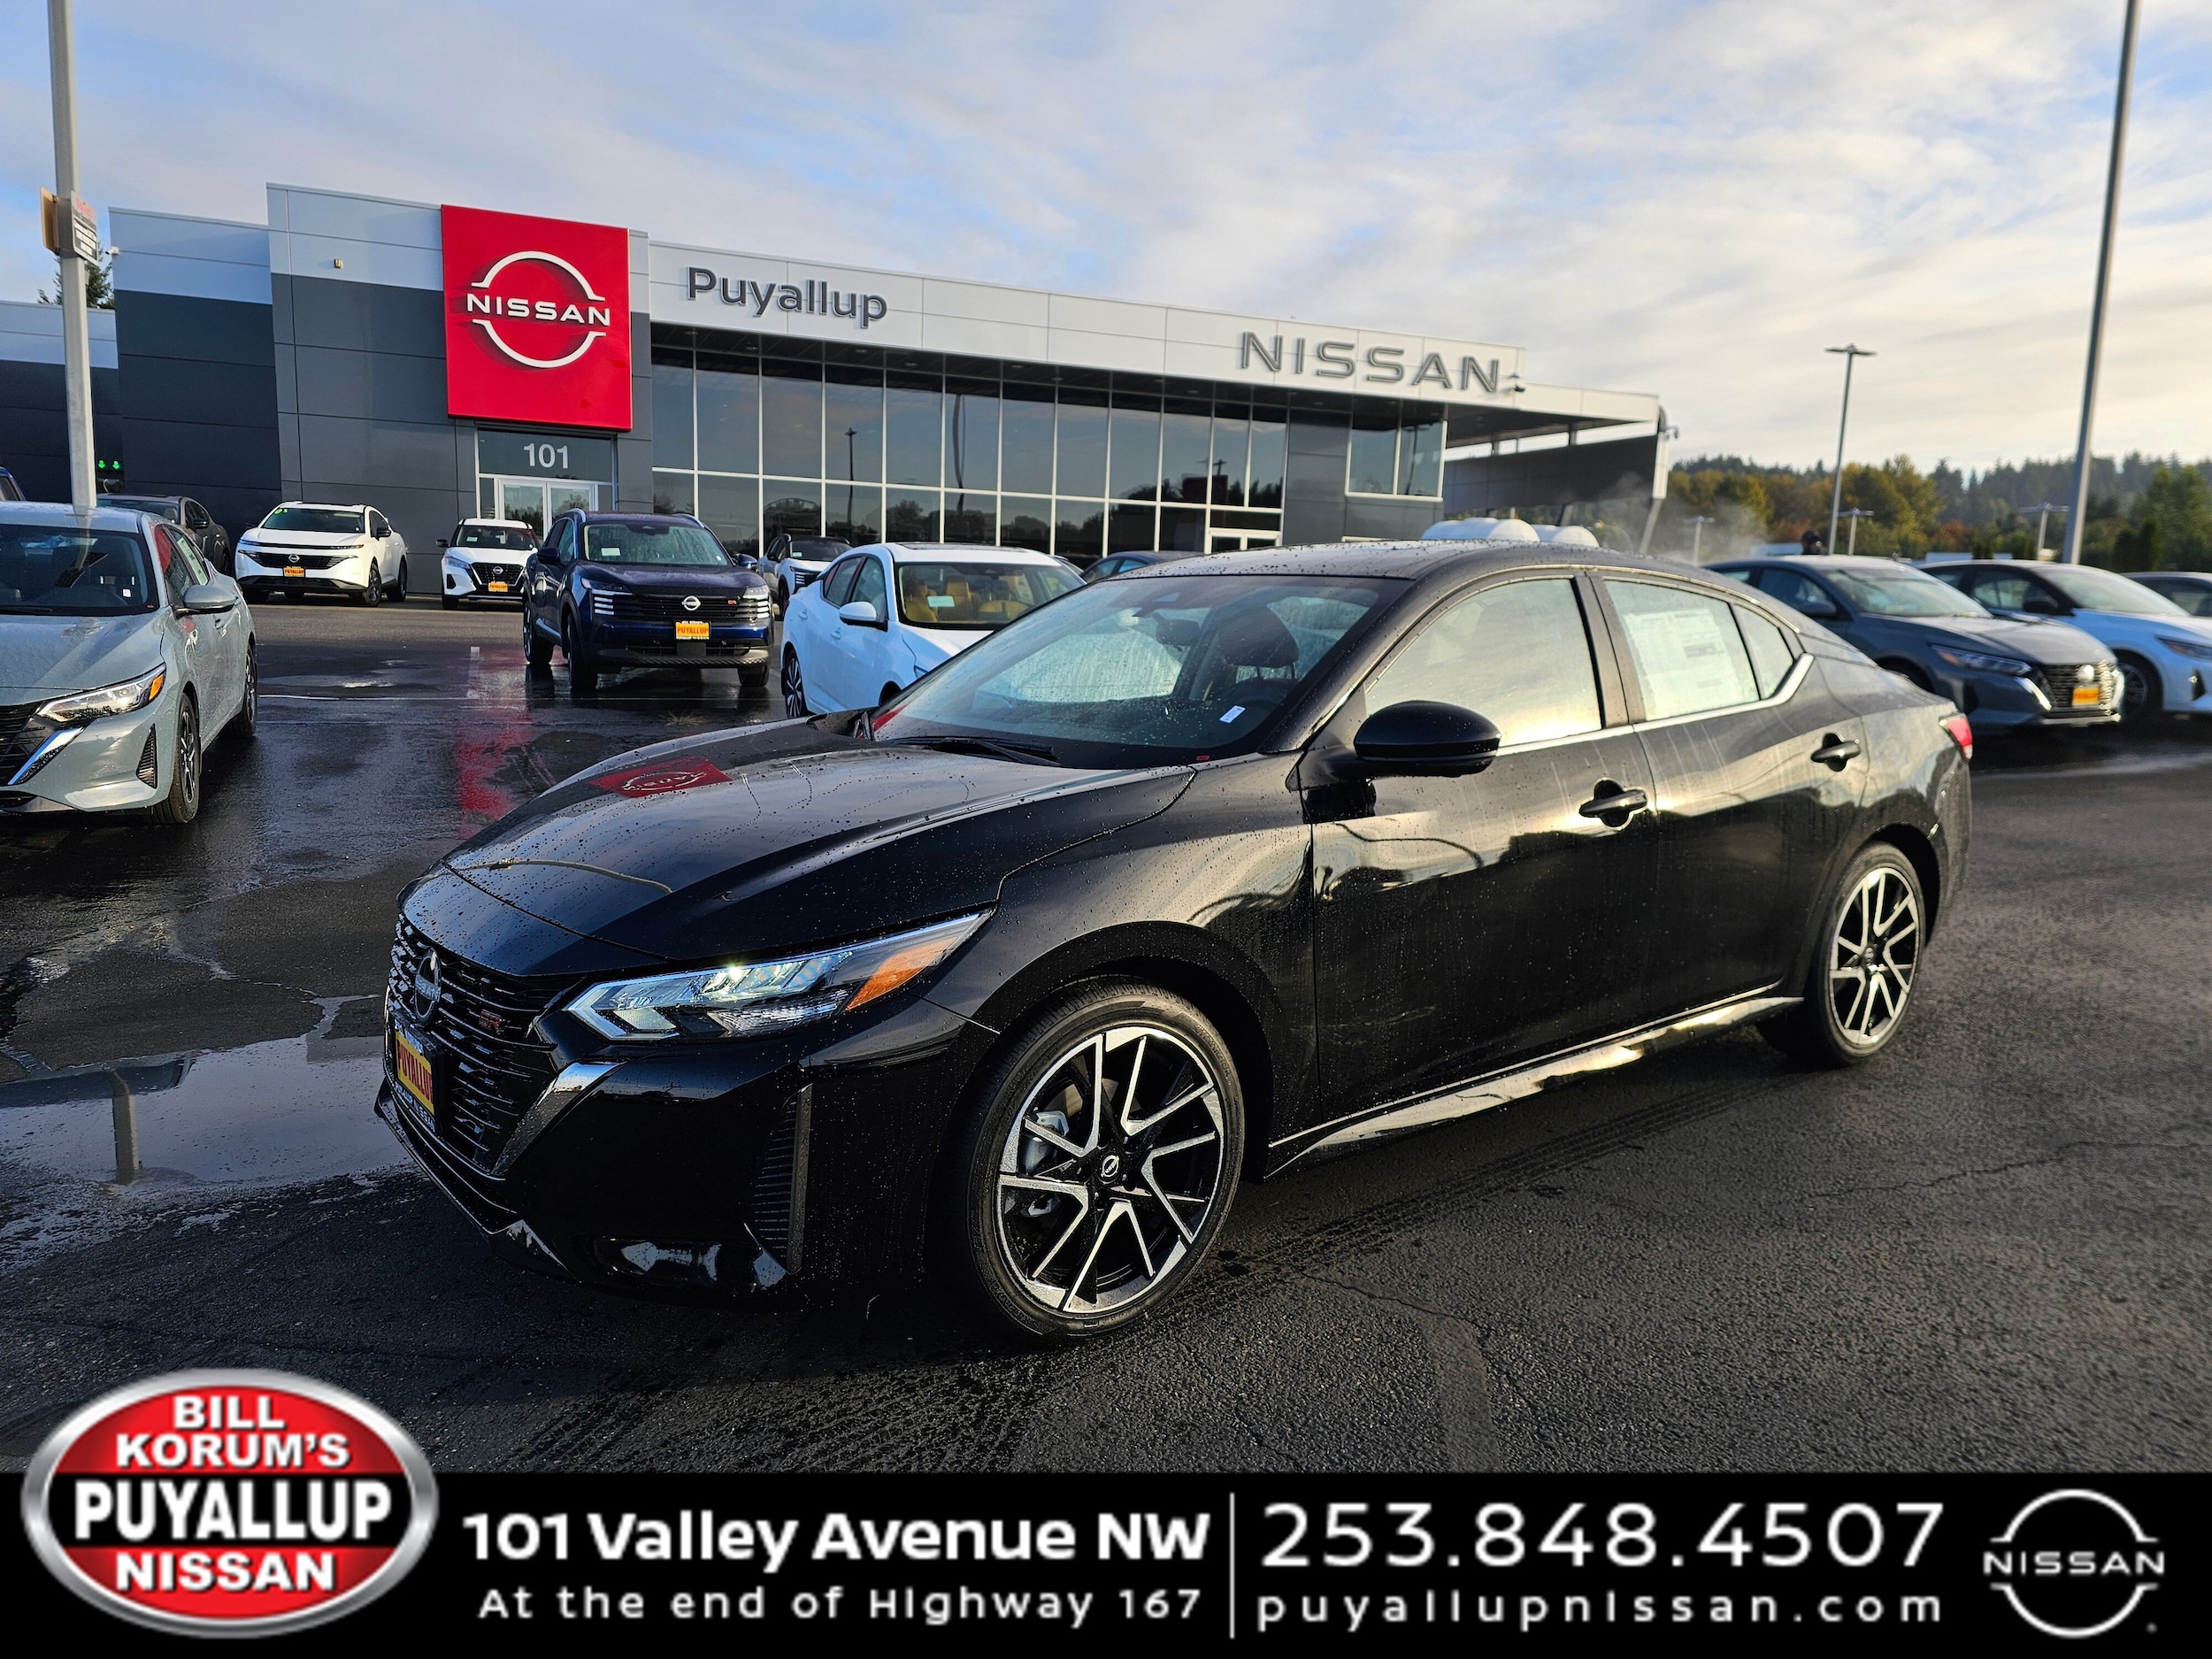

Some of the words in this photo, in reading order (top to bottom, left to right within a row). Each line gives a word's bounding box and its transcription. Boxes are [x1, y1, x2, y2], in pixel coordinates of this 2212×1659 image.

[467, 293, 611, 326] NISSAN
[687, 266, 887, 329] Puyallup
[1240, 331, 1499, 393] NISSAN
[524, 442, 569, 469] 101
